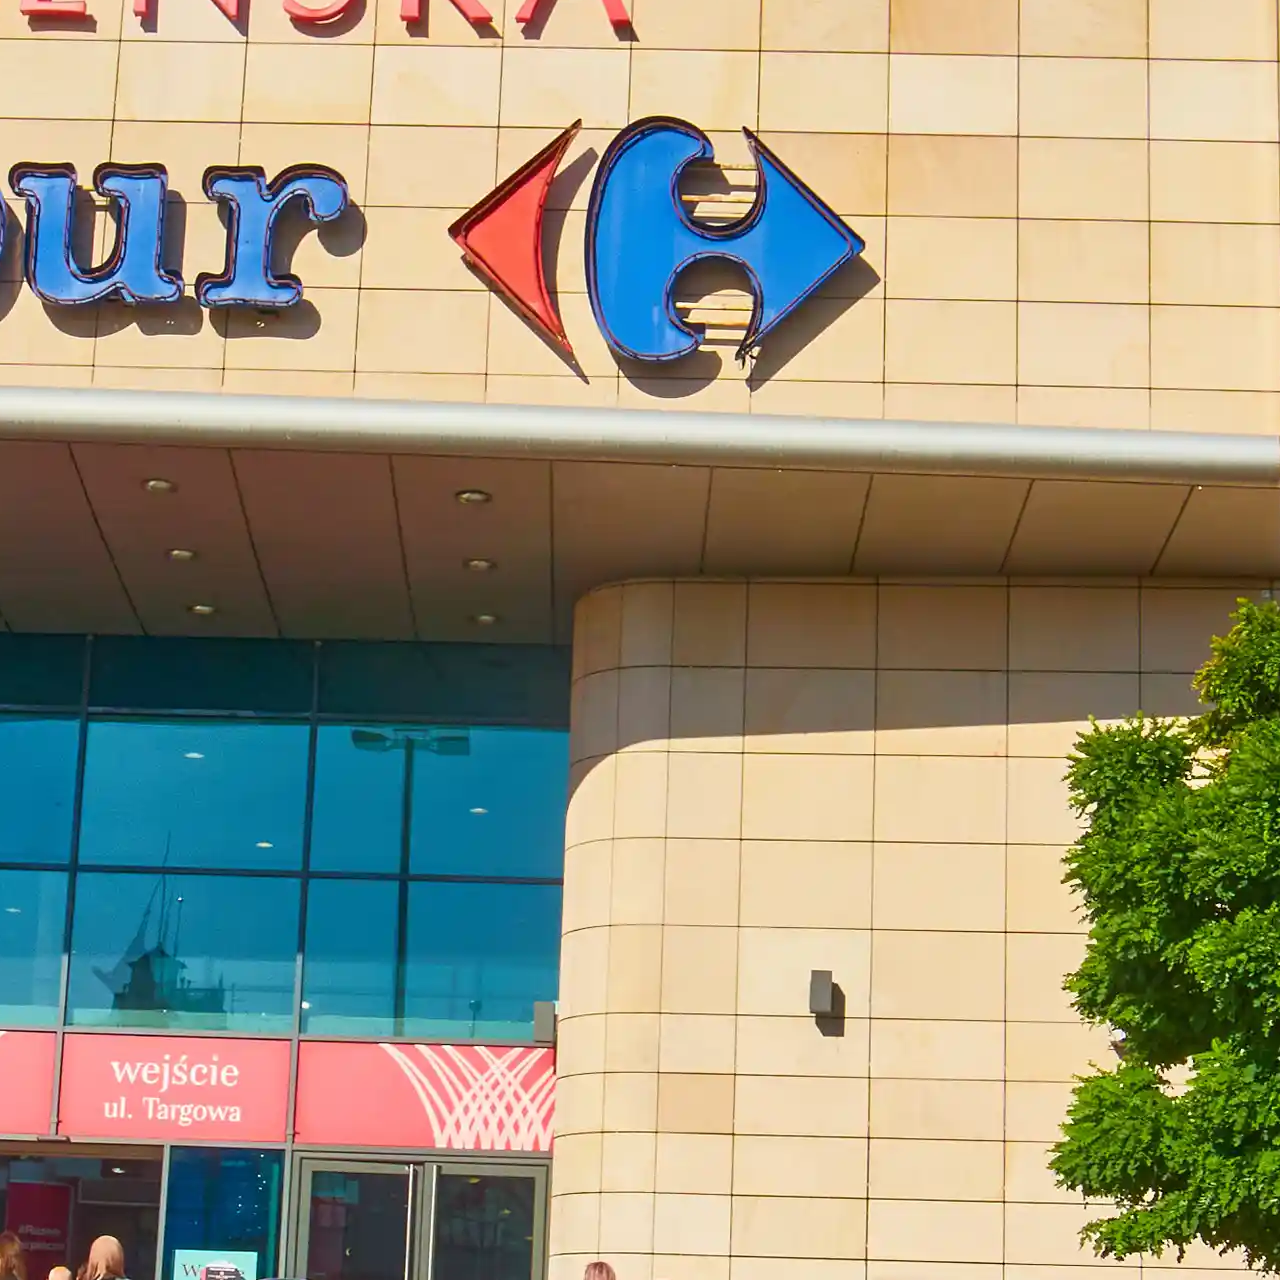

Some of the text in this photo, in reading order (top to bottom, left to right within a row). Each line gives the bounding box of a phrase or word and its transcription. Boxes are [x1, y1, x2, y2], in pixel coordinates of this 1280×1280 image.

[110, 1054, 240, 1092] wejście
[104, 1097, 242, 1127] ul. Targowa
